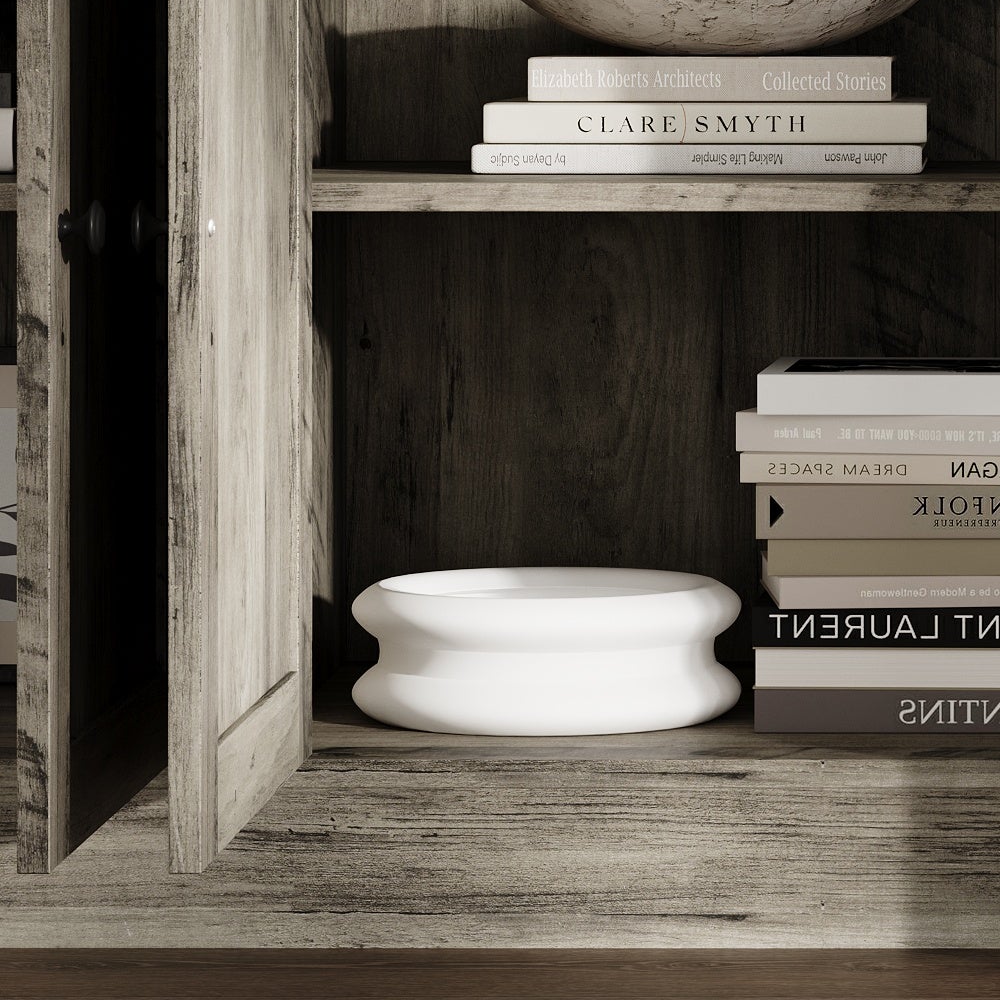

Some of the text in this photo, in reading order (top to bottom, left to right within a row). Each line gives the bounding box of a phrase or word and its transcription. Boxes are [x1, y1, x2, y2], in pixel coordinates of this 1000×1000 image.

[531, 68, 722, 90] Elizabeth Roberts Architects
[762, 71, 887, 92] Collected Stories
[577, 115, 807, 134] CLARE SMYTH
[490, 153, 566, 167] by Deyan Sudjic
[691, 152, 783, 166] Making Life Simpler
[824, 152, 888, 165] John Pawson
